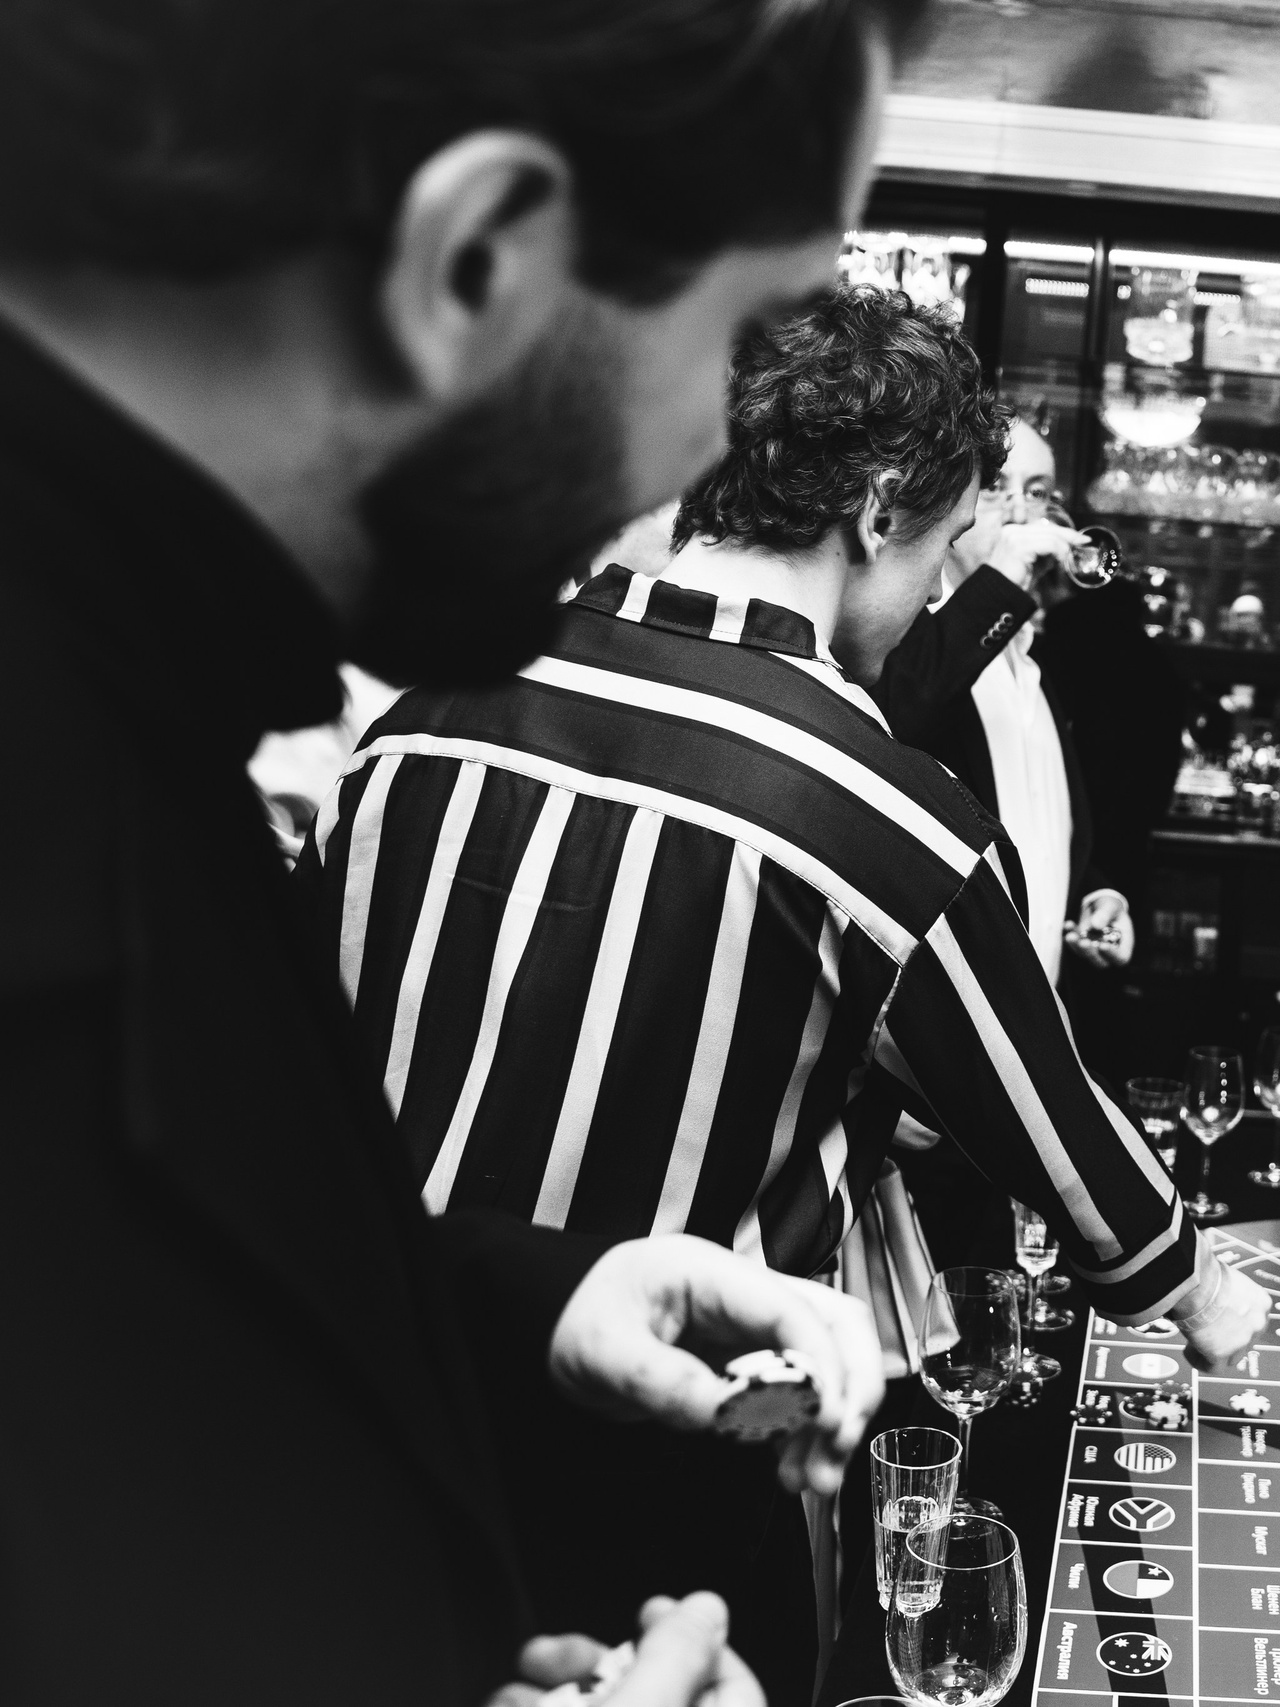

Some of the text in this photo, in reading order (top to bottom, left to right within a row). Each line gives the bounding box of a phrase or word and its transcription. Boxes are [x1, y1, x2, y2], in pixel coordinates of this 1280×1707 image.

[1084, 1445, 1098, 1463] США
[1240, 1472, 1256, 1504] Гриджио
[1258, 1478, 1272, 1500] Пино
[1067, 1493, 1084, 1528] Африка
[1083, 1496, 1099, 1527] Южная
[1251, 1525, 1269, 1555] Мускат
[1068, 1562, 1085, 1590] Чили
[1250, 1587, 1265, 1611] Блан
[1266, 1584, 1280, 1616] Шенен
[1056, 1621, 1078, 1681] Австралия
[1253, 1637, 1269, 1696] Вельтлинер
